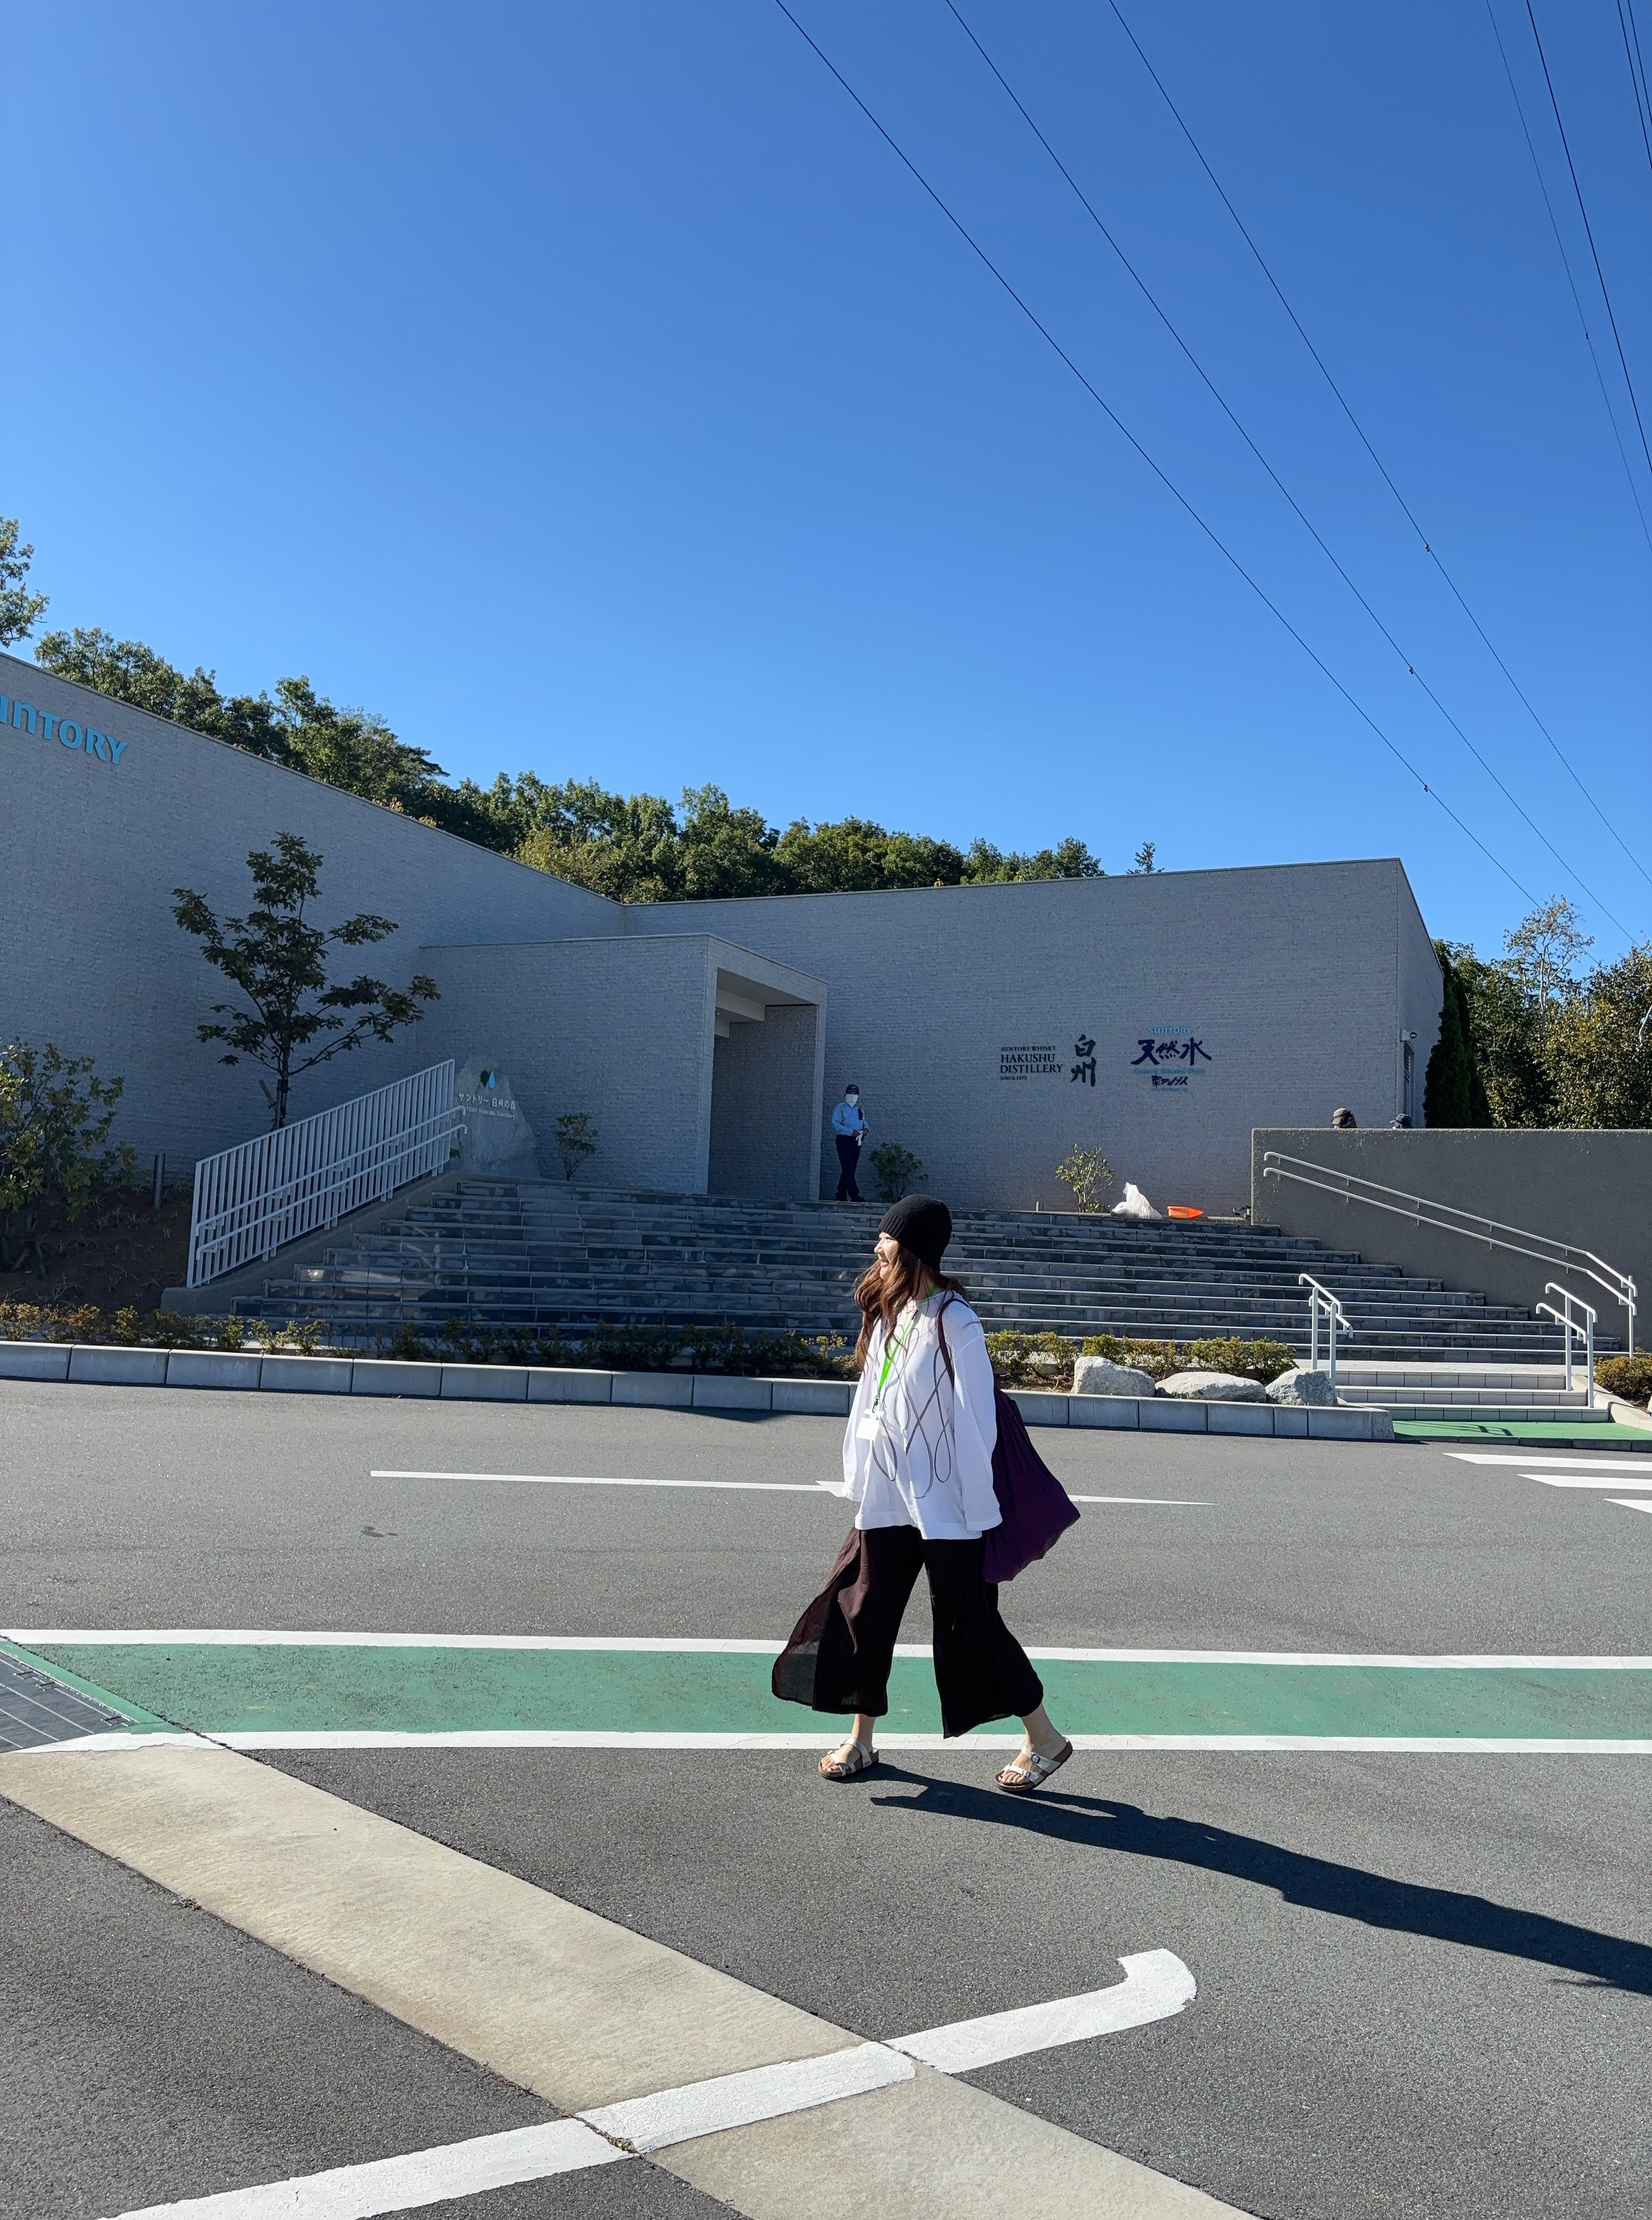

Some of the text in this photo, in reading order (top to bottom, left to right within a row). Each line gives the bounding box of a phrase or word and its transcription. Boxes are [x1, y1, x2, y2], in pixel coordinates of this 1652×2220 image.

[1148, 1026, 1192, 1034] SUNTORY
[1001, 1053, 1055, 1063] HAKUSHU
[1130, 1037, 1212, 1066] 天然水
[1071, 1034, 1096, 1087] 白州
[1000, 1064, 1063, 1073] DISTILLERY
[1151, 1074, 1188, 1088] 南アルプス
[458, 1092, 516, 1110] サントリー 白州の森
